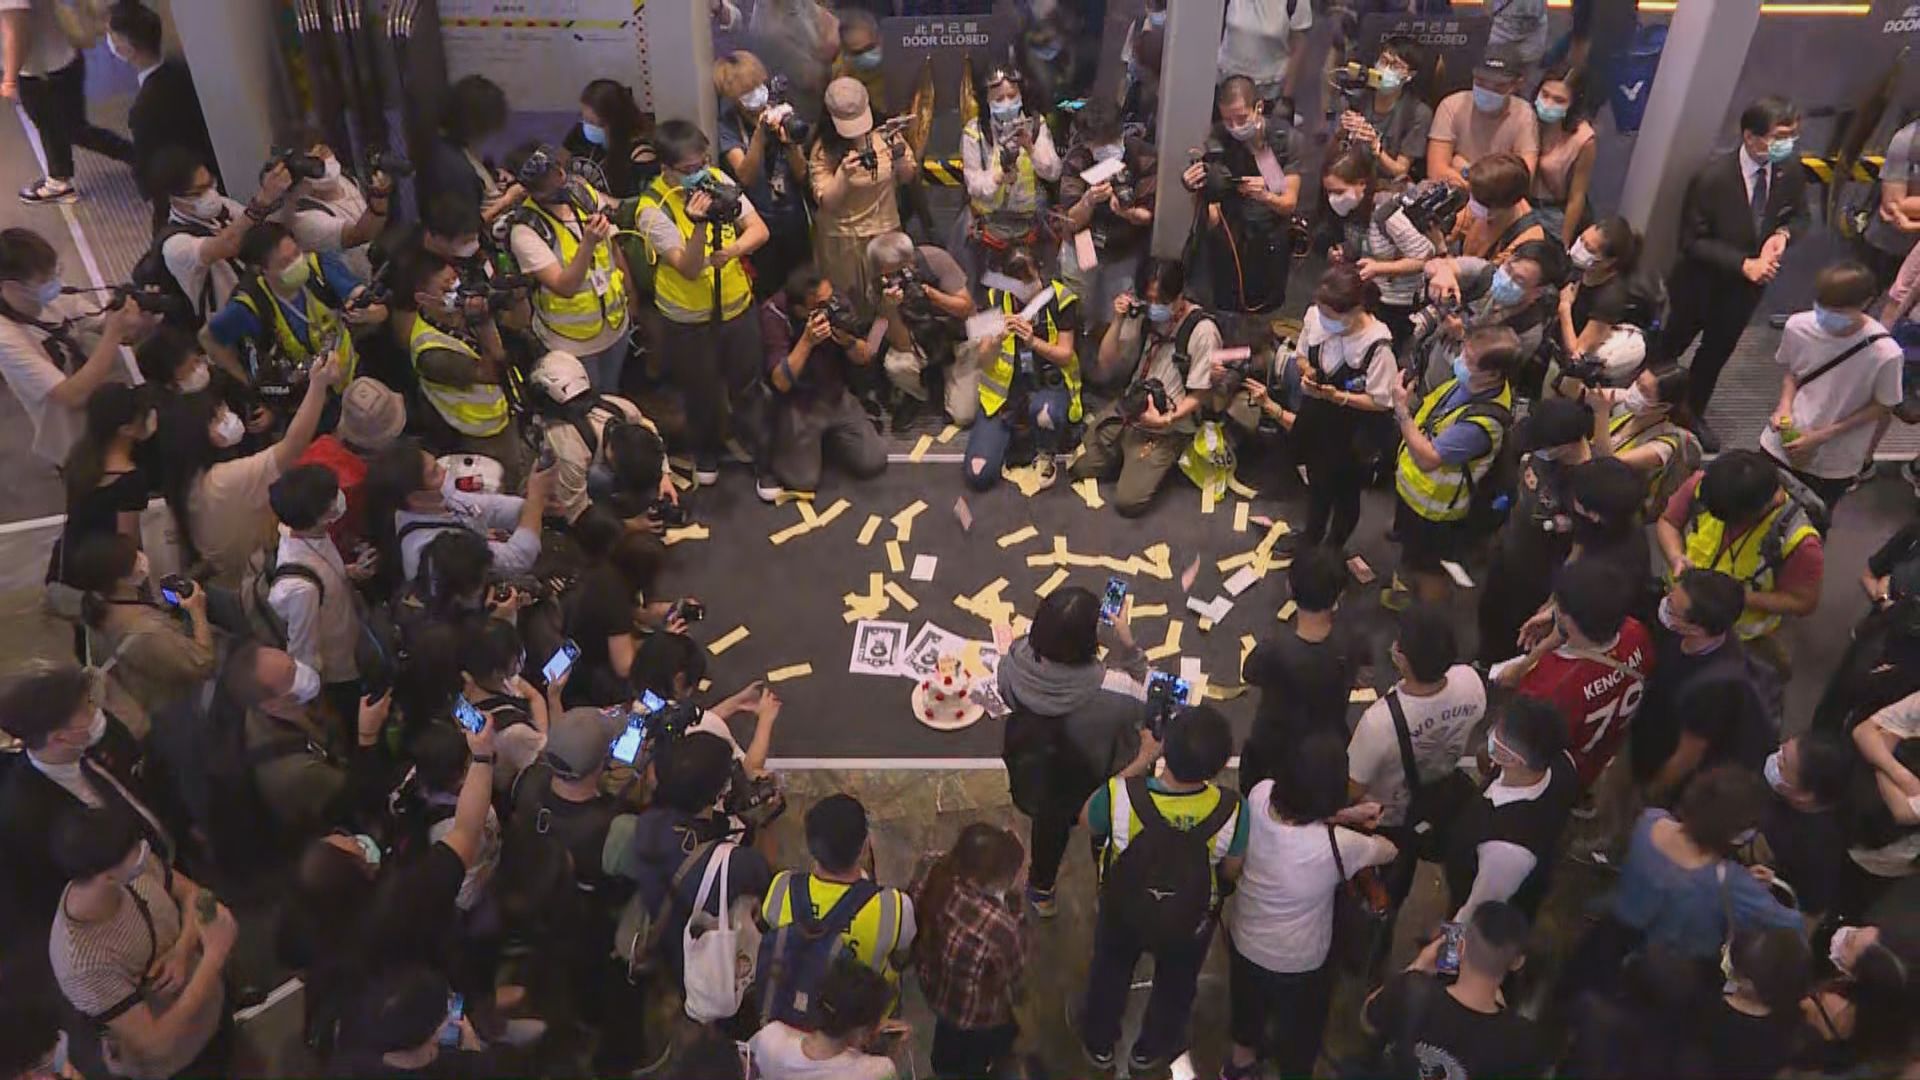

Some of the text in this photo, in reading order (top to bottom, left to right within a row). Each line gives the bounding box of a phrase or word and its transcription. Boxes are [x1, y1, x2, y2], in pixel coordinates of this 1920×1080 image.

[902, 33, 989, 48] DOOR CLOSED
[1583, 646, 1643, 701] KENCAN
